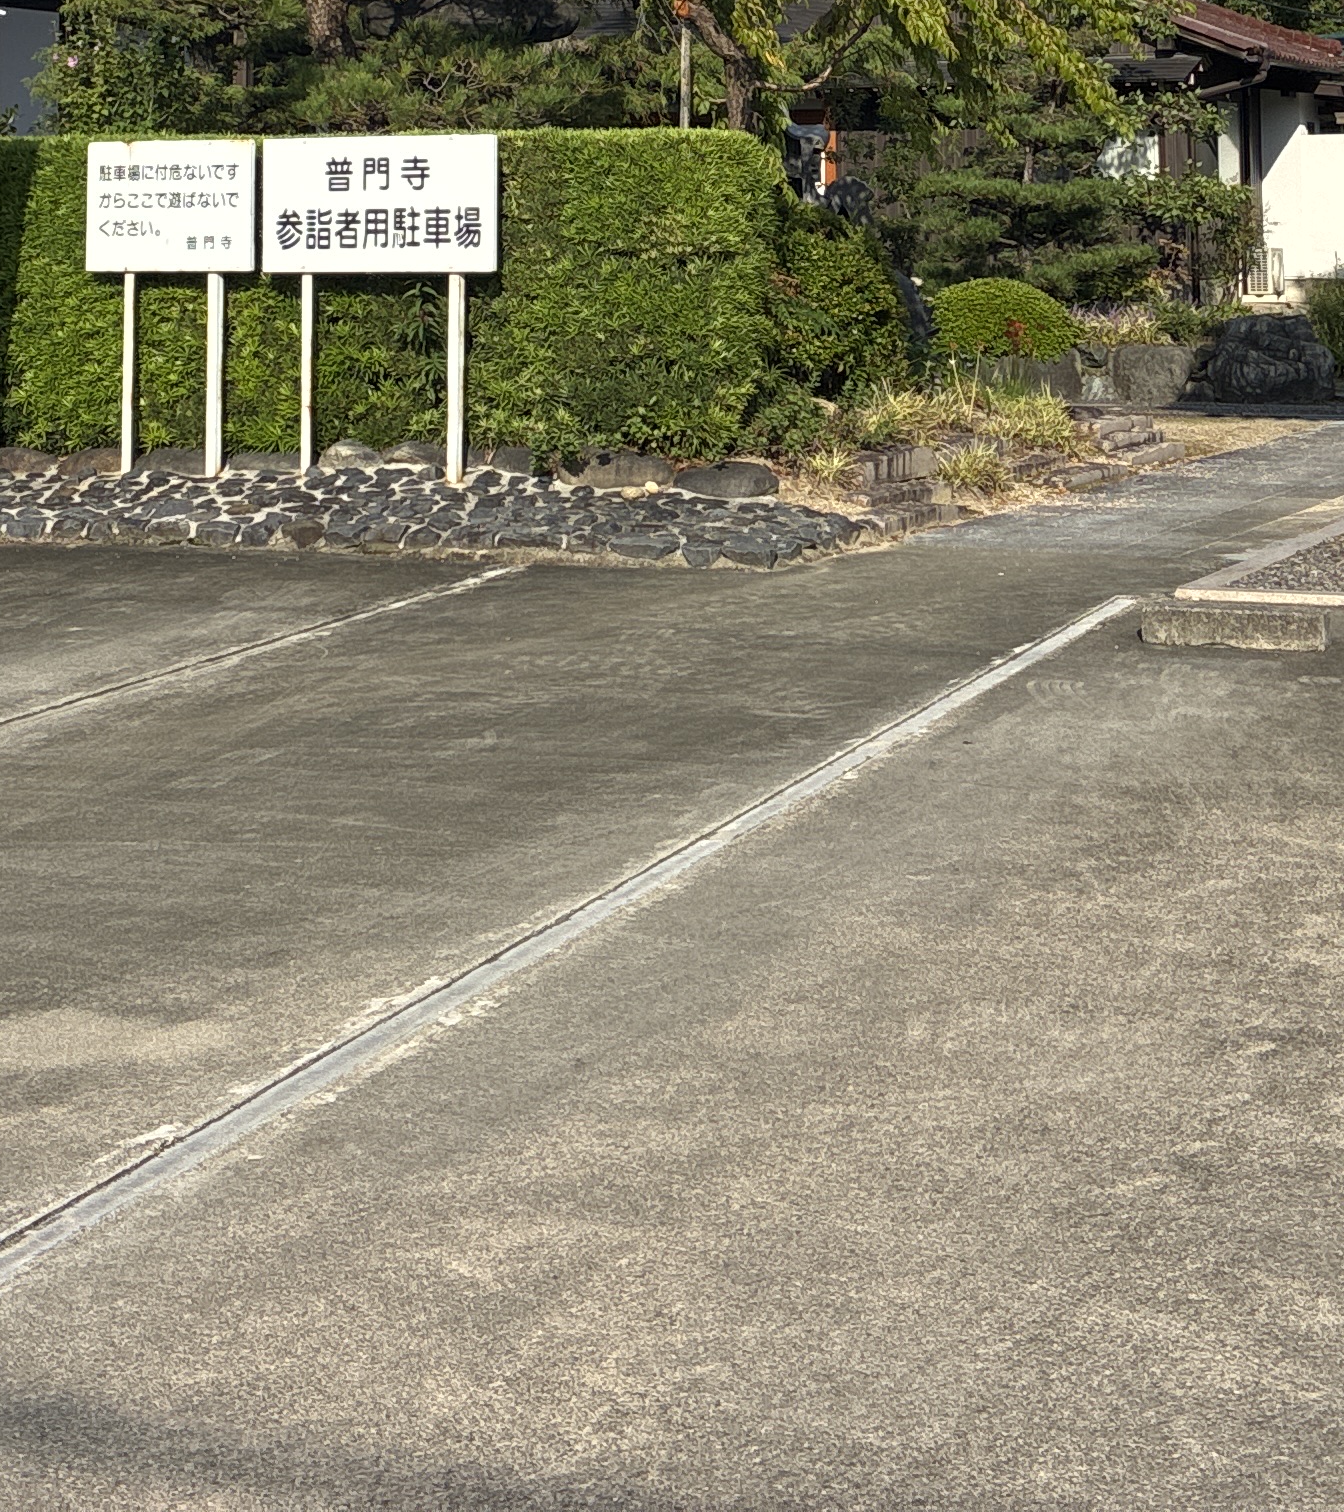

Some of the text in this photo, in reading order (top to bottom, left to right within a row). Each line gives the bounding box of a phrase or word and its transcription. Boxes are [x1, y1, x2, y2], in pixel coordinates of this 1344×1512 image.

[99, 163, 239, 182] 駐車場に付危ないです
[325, 155, 431, 192] 普門寺
[99, 192, 239, 209] からここで遊ばないで
[99, 220, 161, 237] ください。
[275, 206, 482, 250] 参詣者用駐車場
